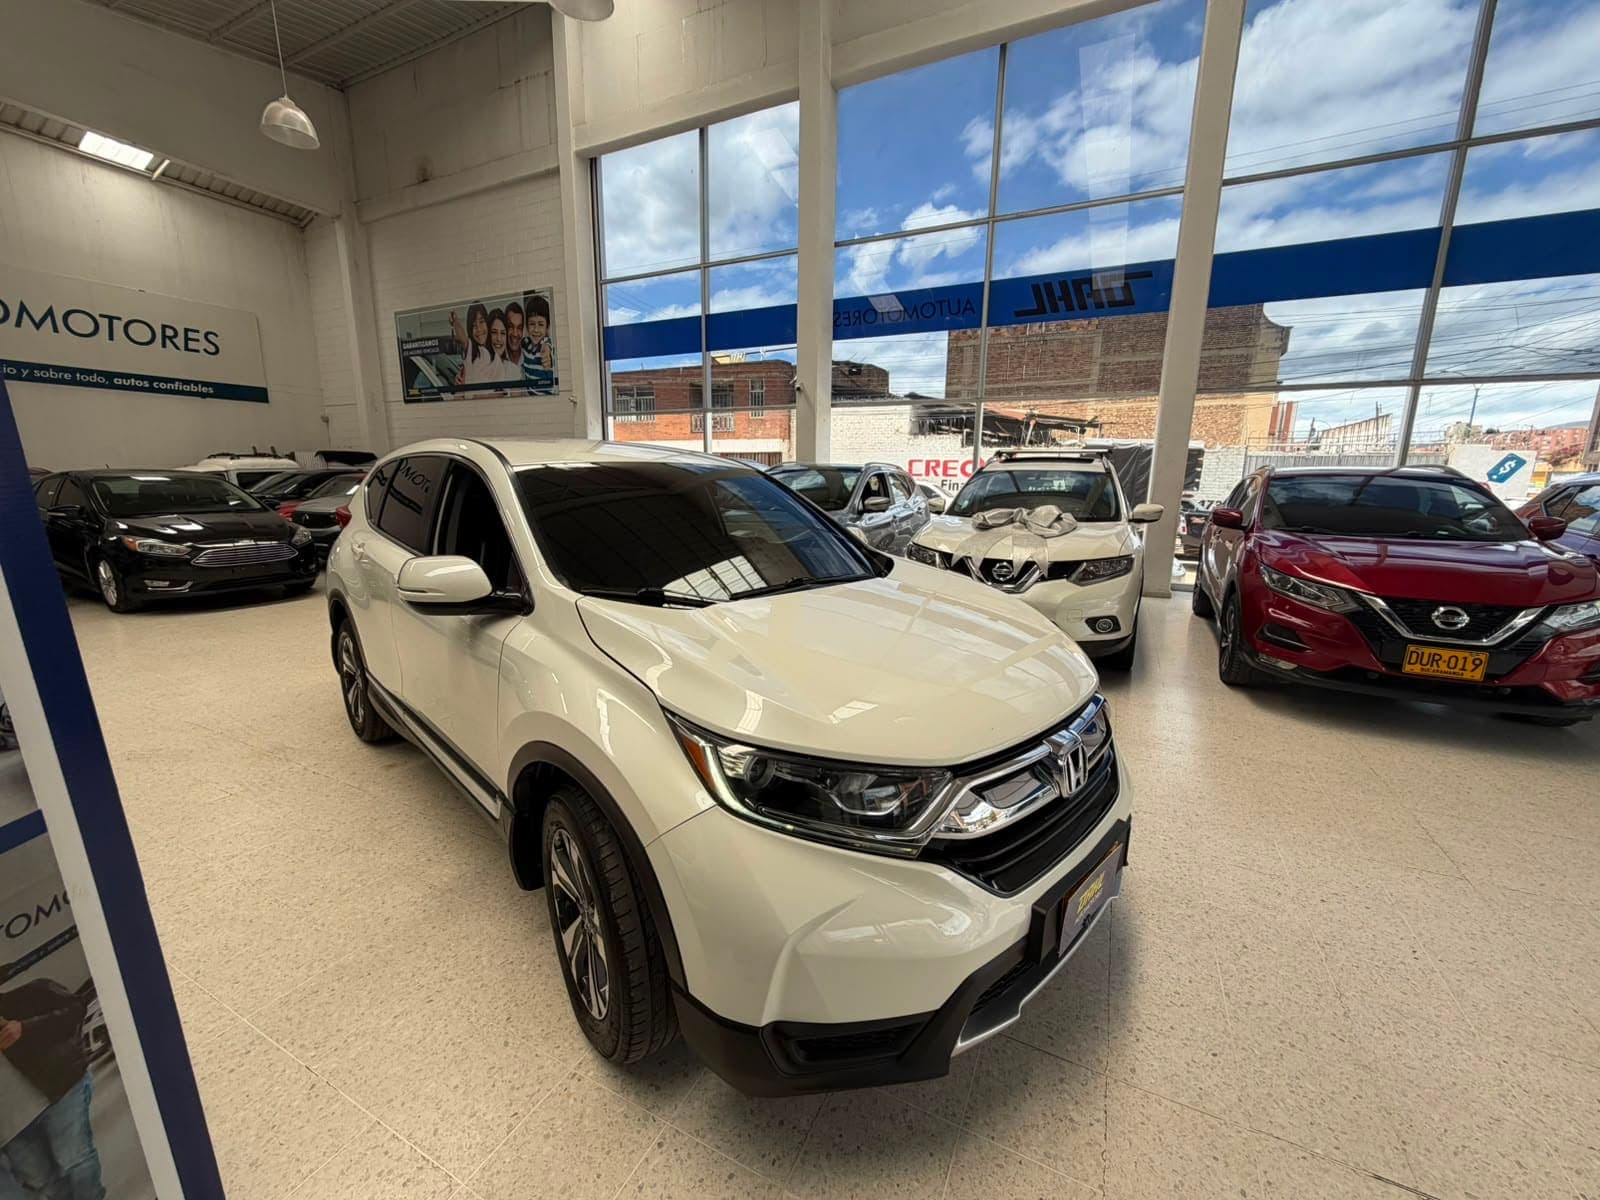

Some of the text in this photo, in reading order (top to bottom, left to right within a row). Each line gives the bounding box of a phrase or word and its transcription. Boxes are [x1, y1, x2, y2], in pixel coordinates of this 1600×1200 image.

[0, 299, 220, 356] MOTORES
[20, 368, 30, 378] y
[33, 368, 72, 381] sobre
[75, 371, 110, 385] todo,
[113, 376, 150, 388] autos
[153, 379, 214, 394] confiables
[0, 889, 71, 939] OM
